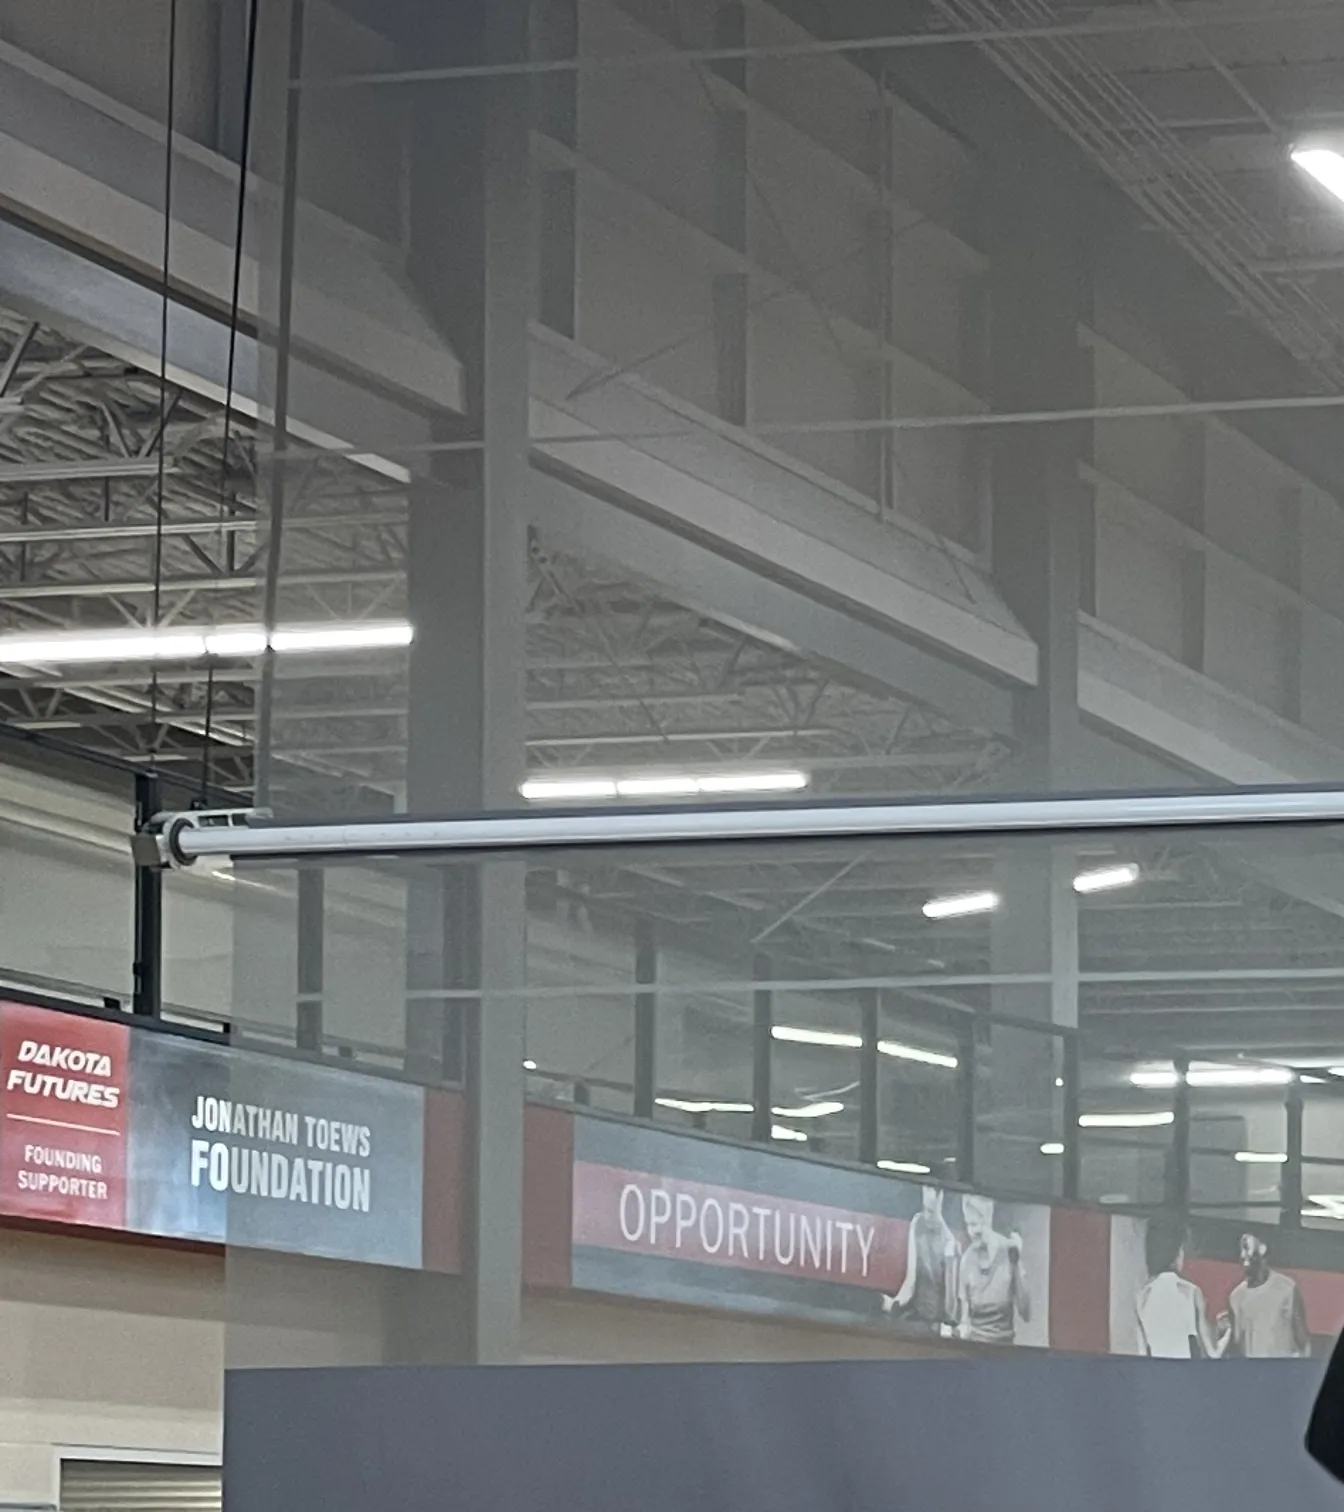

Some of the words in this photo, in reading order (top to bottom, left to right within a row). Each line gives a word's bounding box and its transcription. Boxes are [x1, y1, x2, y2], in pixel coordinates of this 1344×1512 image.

[18, 1040, 111, 1077] DAKOTA
[7, 1069, 120, 1108] FUTURES
[191, 1095, 298, 1145] JONATHAN
[304, 1116, 371, 1157] TOEWS
[24, 1145, 102, 1174] FOUNDING
[191, 1139, 370, 1212] FOUNDATION
[18, 1170, 108, 1199] SUPPORTER
[619, 1184, 875, 1277] OPPORTUNITY
